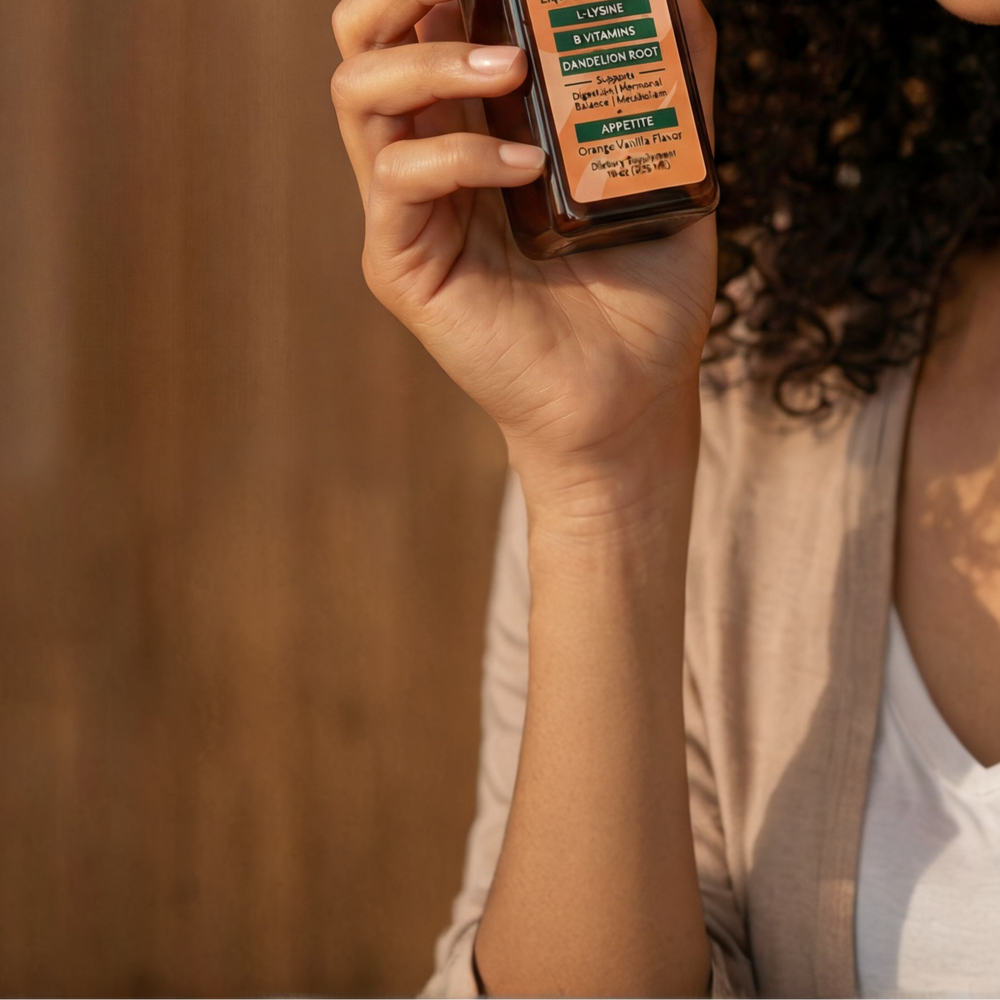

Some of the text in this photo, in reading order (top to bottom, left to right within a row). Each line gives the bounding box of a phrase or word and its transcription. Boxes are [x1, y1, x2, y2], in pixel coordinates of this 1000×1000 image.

[576, 3, 624, 20] L-LYSINE
[573, 25, 636, 45] B VITAMINS
[562, 46, 658, 72] DANDELION ROOT
[601, 116, 655, 135] APPETITE
[578, 143, 615, 156] Orange
[652, 131, 682, 144] Flavor
